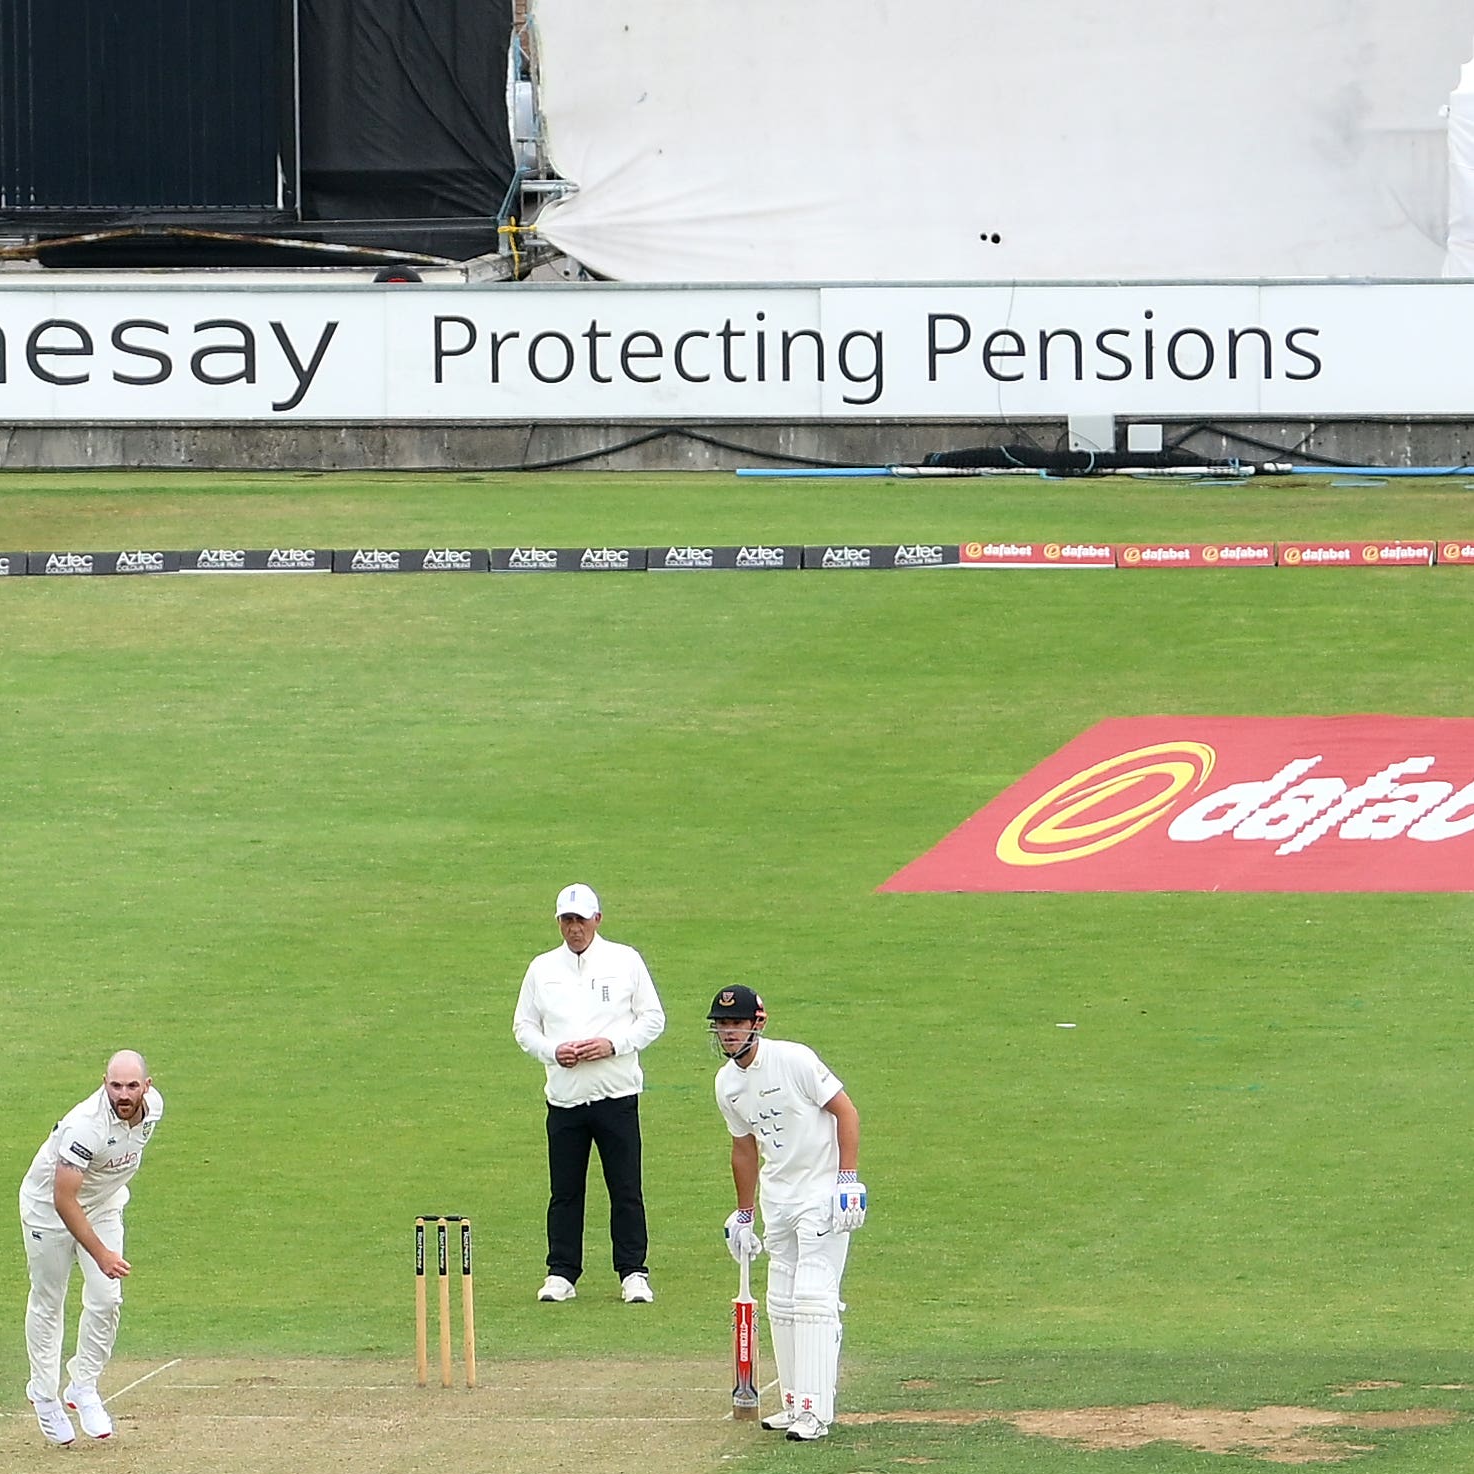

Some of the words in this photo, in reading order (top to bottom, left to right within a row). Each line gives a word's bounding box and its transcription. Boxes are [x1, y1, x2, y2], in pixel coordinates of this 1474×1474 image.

[434, 312, 884, 406] Protecting
[928, 310, 1322, 382] Pensions
[115, 550, 164, 564] Aztec
[196, 547, 245, 561] Aztec
[267, 546, 316, 560] Aztec
[351, 548, 400, 562] Aztec
[422, 547, 471, 561] Aztec
[508, 547, 557, 561] Aztec
[580, 547, 629, 561] Aztec
[664, 545, 713, 559] Aztec
[735, 545, 784, 559] Aztec
[821, 546, 870, 560] Aztec
[894, 543, 943, 557] Aztec
[982, 544, 1031, 558] dafabet
[1061, 545, 1110, 559] dafabet
[1141, 548, 1190, 562] dafabet
[1219, 546, 1268, 560] dafabet
[1301, 548, 1350, 562] dafabet
[1379, 546, 1428, 560] dafabet
[45, 552, 94, 566] Aztec
